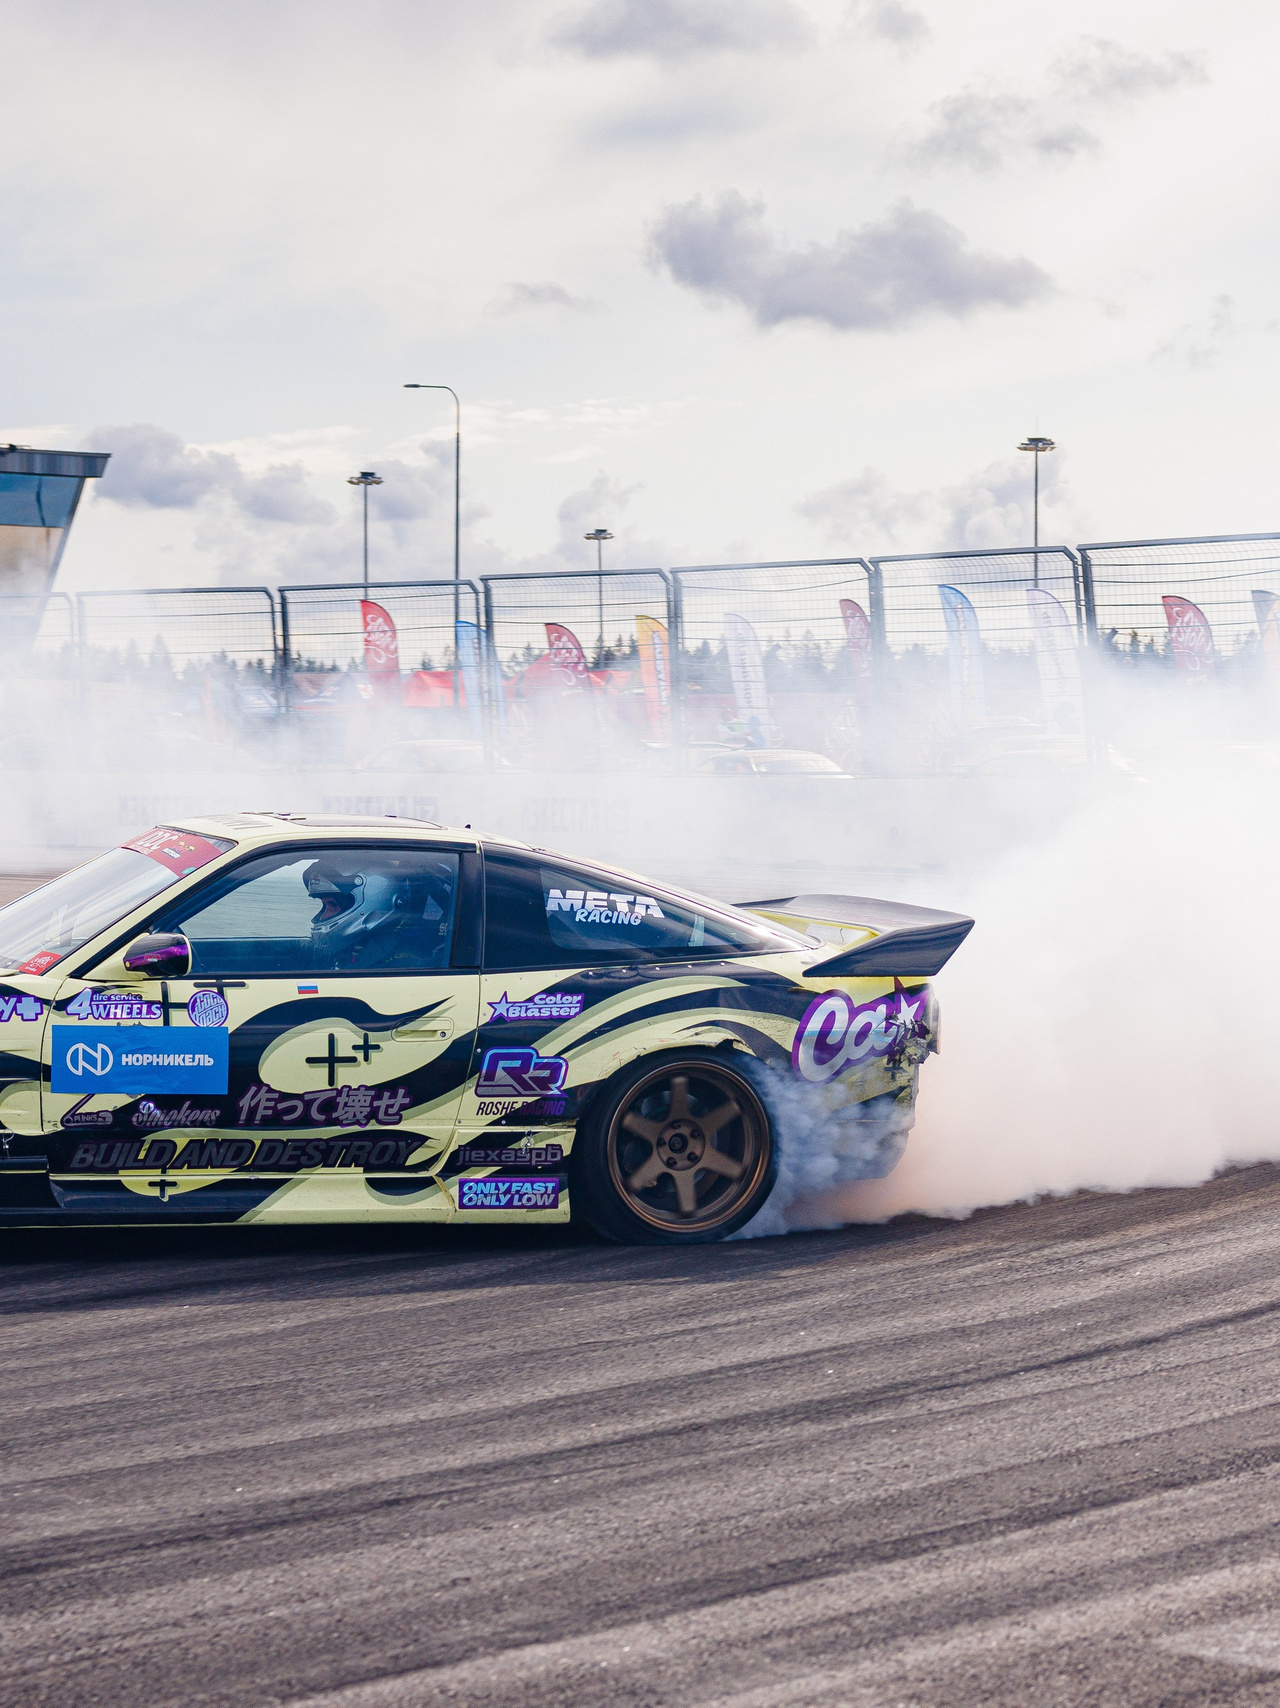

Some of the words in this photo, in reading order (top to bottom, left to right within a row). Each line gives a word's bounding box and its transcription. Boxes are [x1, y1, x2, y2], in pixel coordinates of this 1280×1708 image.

[546, 888, 665, 918] META
[575, 909, 642, 925] RACING
[66, 987, 93, 1019] 4
[91, 1003, 162, 1019] WHEELS
[533, 993, 582, 1004] Color
[508, 1006, 580, 1018] Blaster
[121, 1053, 214, 1067] НОРНИКЕЛЬ
[238, 1085, 411, 1124] 作って壊せ
[476, 1101, 519, 1116] ROSHE
[519, 1101, 566, 1117] RACING
[73, 1114, 98, 1122] PUNKS
[132, 1100, 221, 1127] Smokers
[70, 1142, 173, 1168] BUILD
[175, 1141, 254, 1169] AND
[255, 1140, 422, 1166] DESTROY
[463, 1182, 511, 1194] ONLY
[511, 1182, 556, 1195] FAST
[462, 1194, 511, 1206] ONLY
[512, 1194, 556, 1206] LOW
